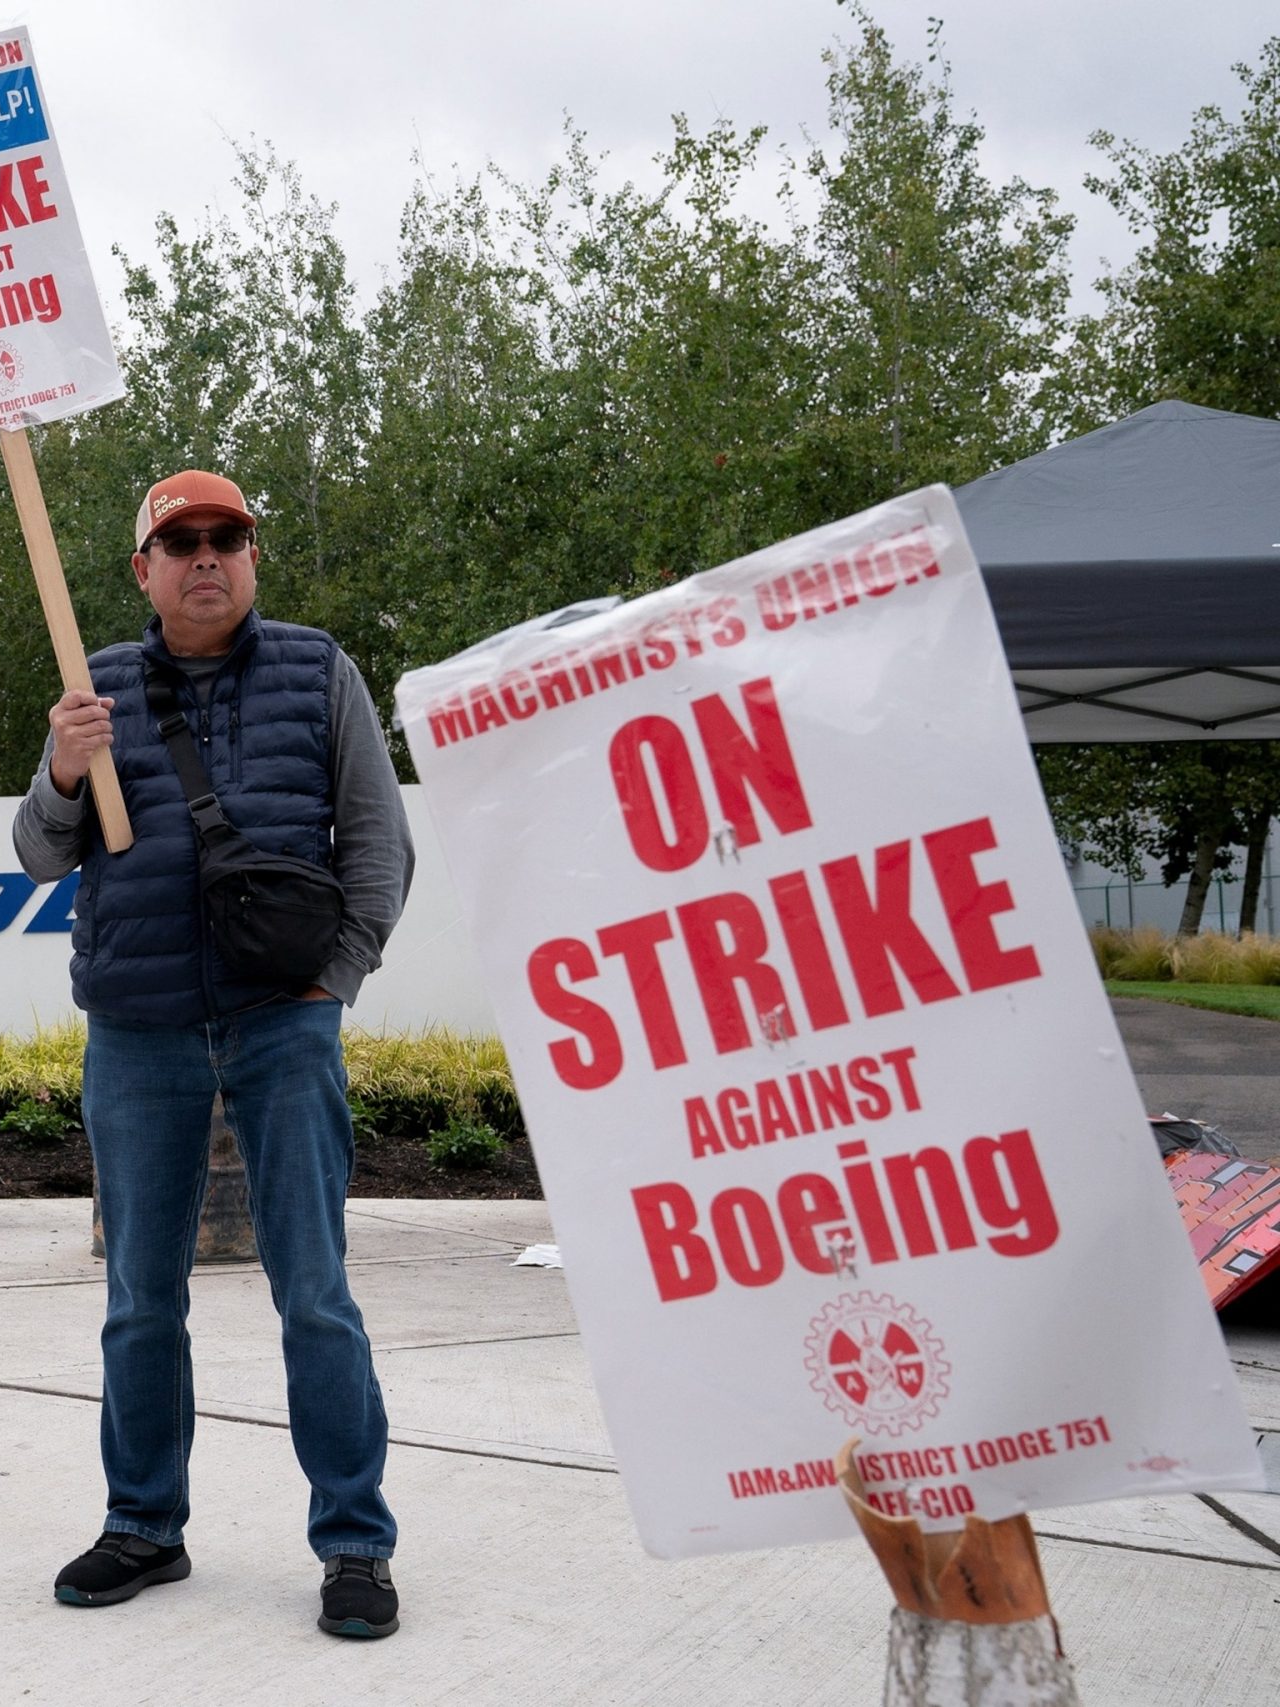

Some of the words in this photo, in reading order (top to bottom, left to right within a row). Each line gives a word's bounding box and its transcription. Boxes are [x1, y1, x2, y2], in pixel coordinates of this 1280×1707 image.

[27, 388, 58, 406] LODGE
[59, 382, 77, 397] 751
[153, 494, 168, 510] DO
[155, 497, 188, 519] GOOD.
[424, 596, 747, 749] MACHINISTS
[754, 524, 942, 635] UNION
[608, 675, 814, 874] ON
[526, 815, 1044, 1092] STRIKE
[683, 1046, 923, 1161] AGAINST
[631, 1128, 1061, 1304] Boeing
[727, 1458, 838, 1499] IAM&AW
[858, 1445, 960, 1483] ISTRICT
[962, 1429, 1058, 1471] LODGE
[1057, 1415, 1112, 1451] 751
